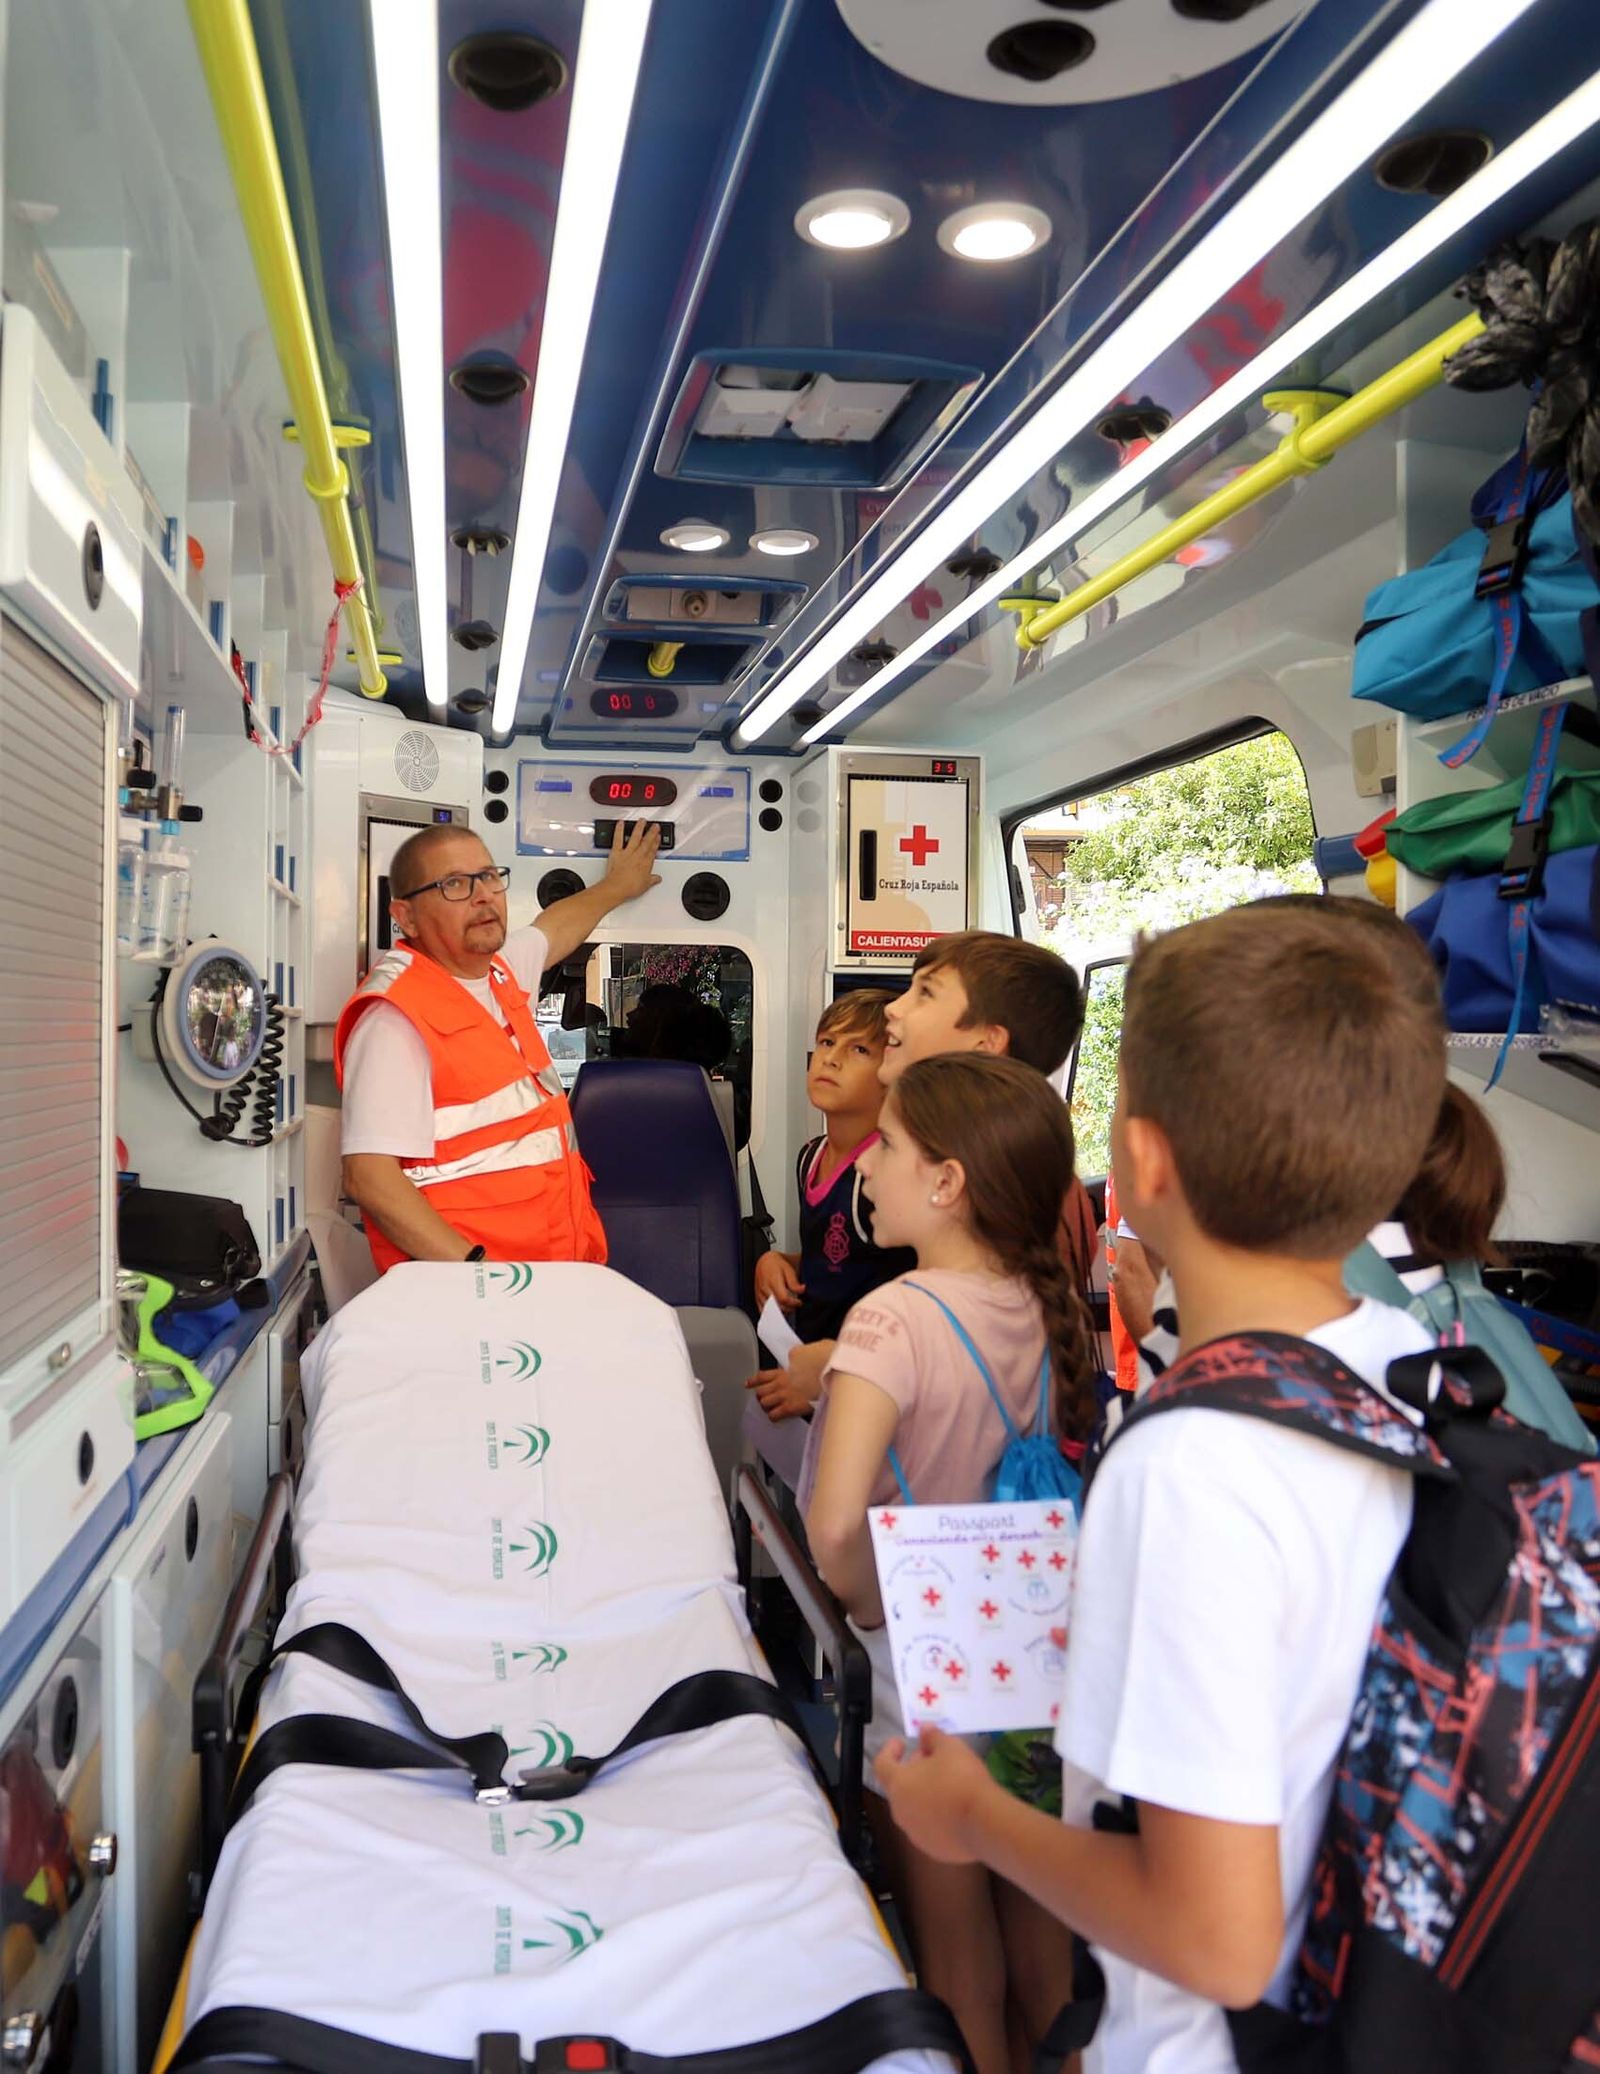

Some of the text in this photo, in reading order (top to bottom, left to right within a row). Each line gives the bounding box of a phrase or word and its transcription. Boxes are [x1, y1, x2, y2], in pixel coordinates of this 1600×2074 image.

[609, 783, 656, 799] 00 8
[879, 879, 960, 892] Cruz Roja Española
